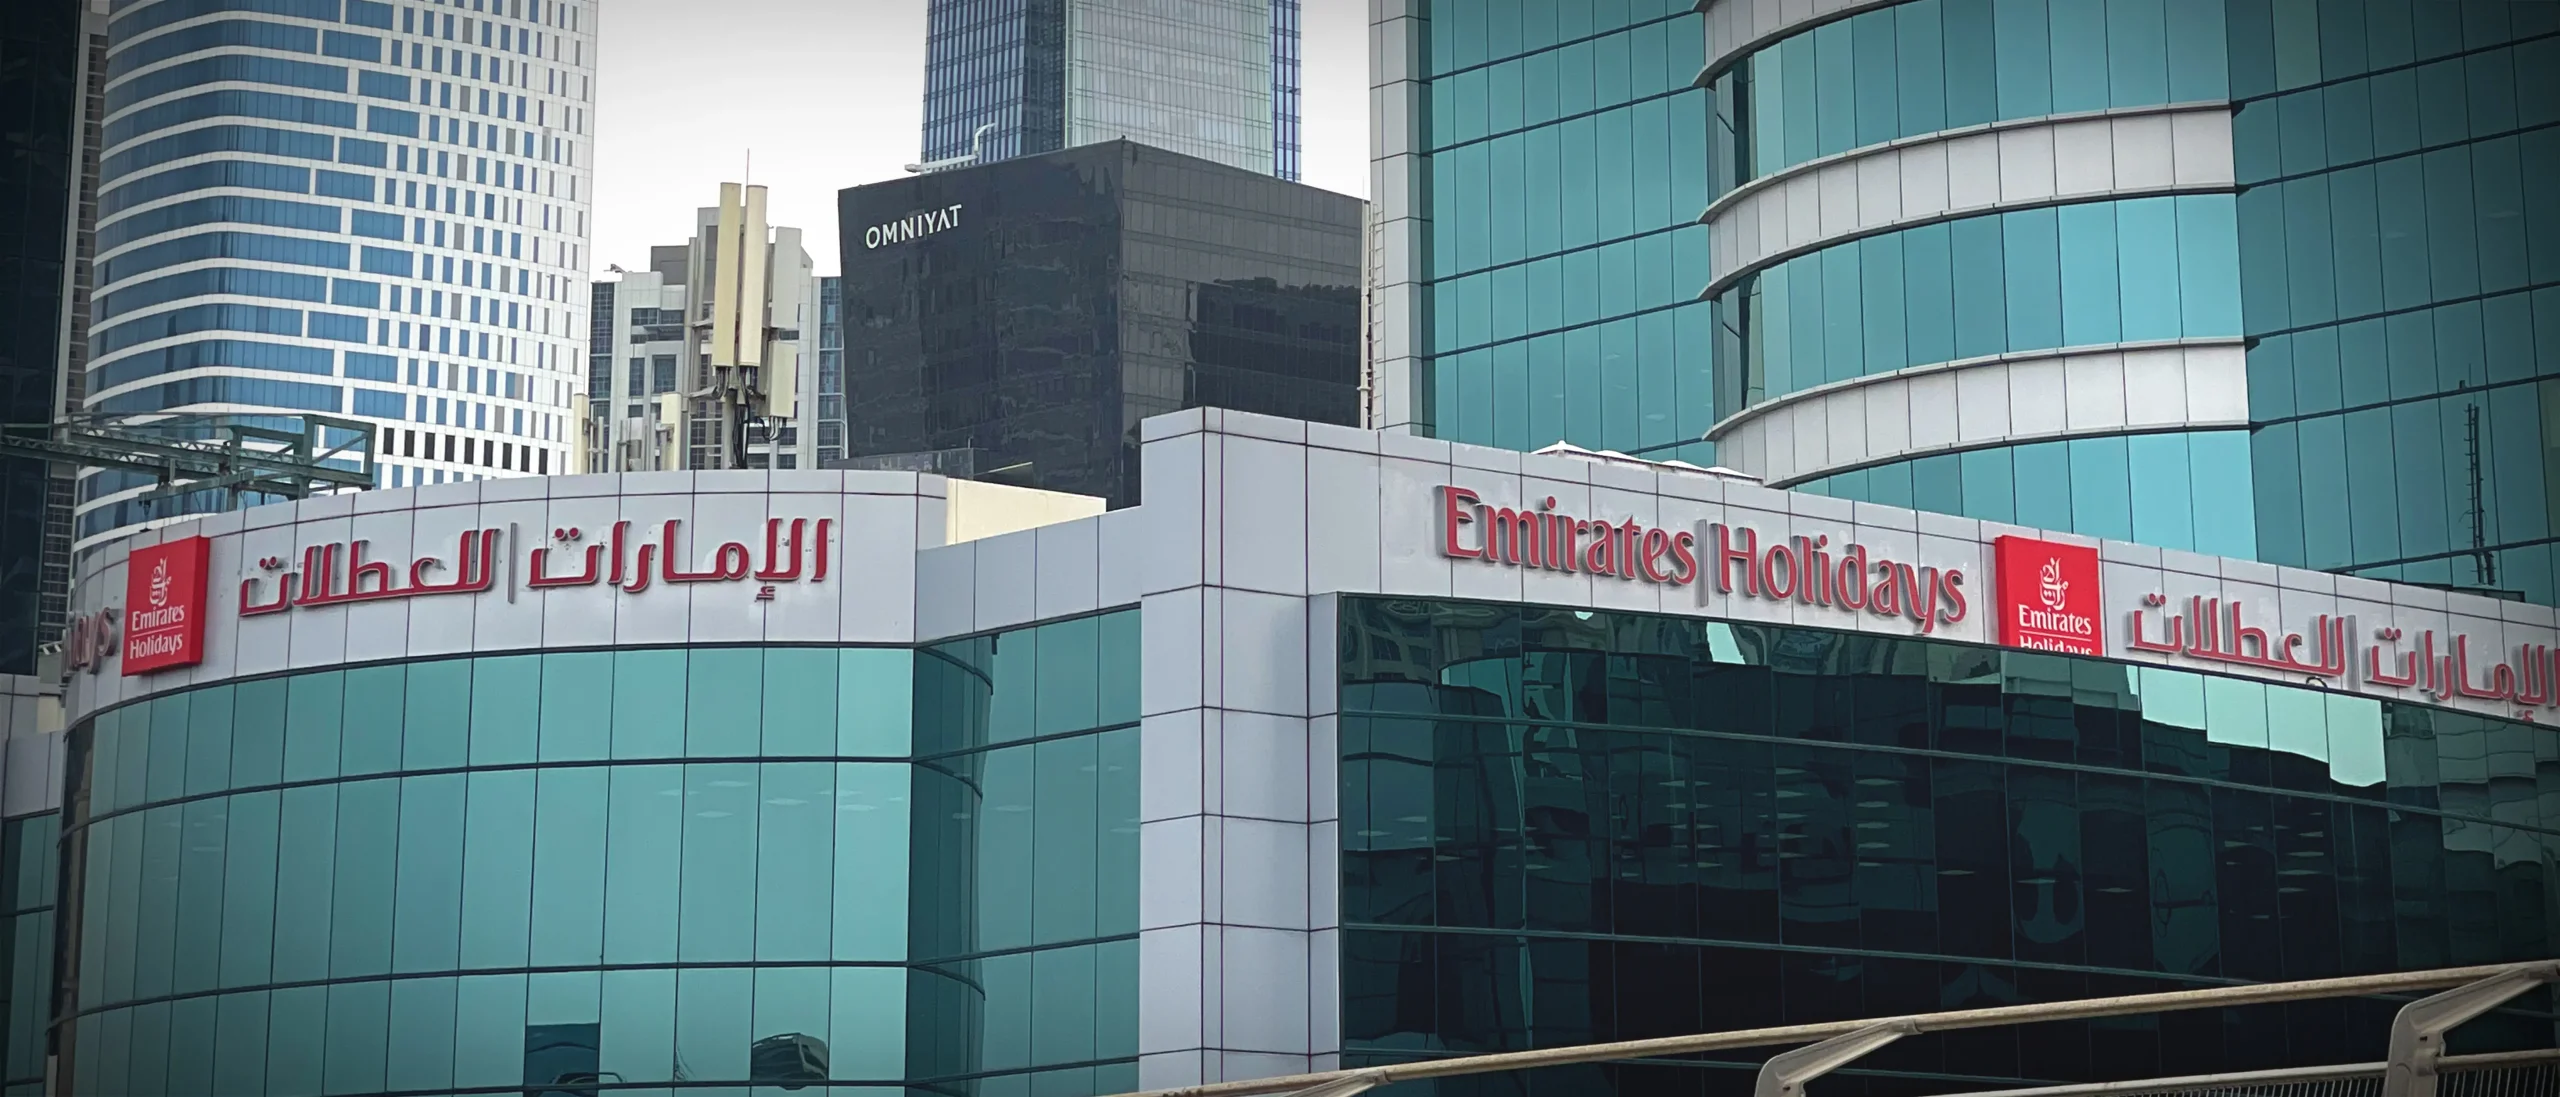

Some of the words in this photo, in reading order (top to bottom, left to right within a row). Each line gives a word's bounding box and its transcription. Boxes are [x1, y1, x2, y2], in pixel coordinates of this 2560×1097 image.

[865, 203, 963, 250] OMNIYAT
[238, 527, 500, 617] للعطلات
[528, 516, 834, 601] الإمارات
[1438, 484, 1697, 586] Emirates
[1713, 522, 1968, 635] Holidays
[129, 633, 183, 660] Holidays
[131, 604, 185, 632] Emirates
[2018, 603, 2092, 635] Emirates
[2128, 592, 2346, 677] للعطلات
